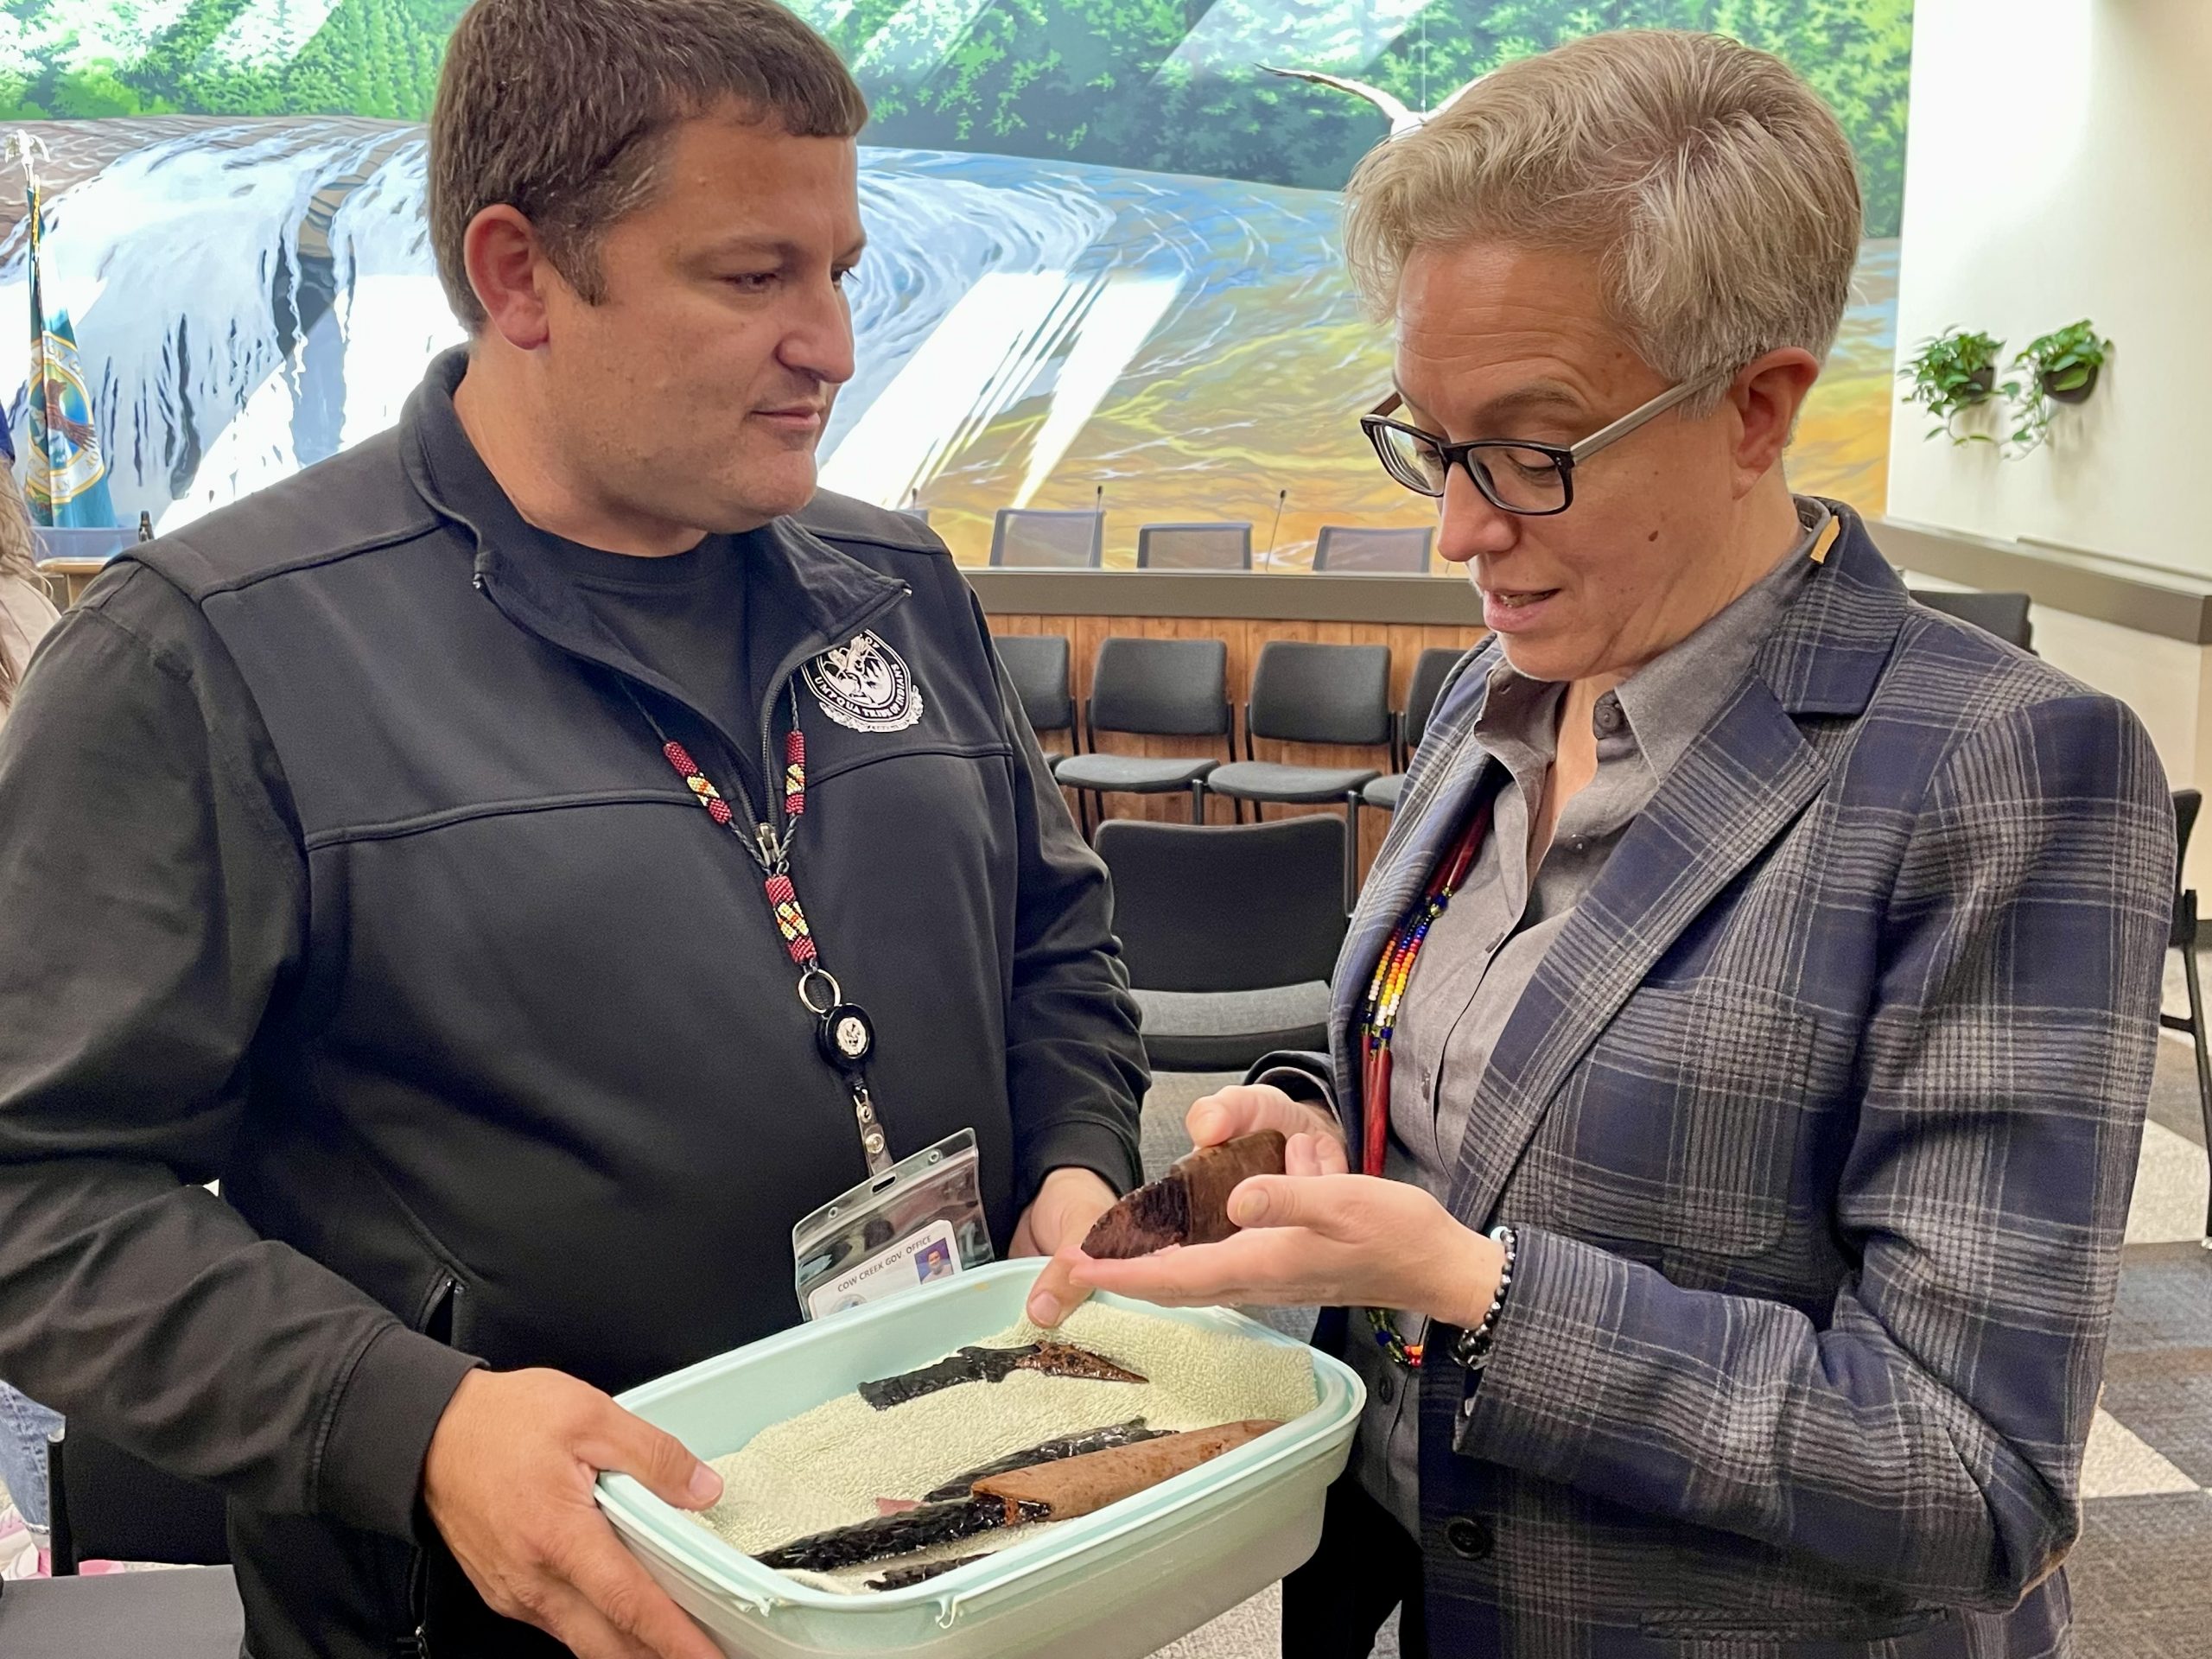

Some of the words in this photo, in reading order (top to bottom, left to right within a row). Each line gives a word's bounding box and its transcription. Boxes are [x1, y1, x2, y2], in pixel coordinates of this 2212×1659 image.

[815, 677, 861, 713] UMPQUA
[838, 1276, 857, 1292] COW
[859, 1262, 884, 1281] CREEK
[906, 1236, 931, 1254] OFFICE
